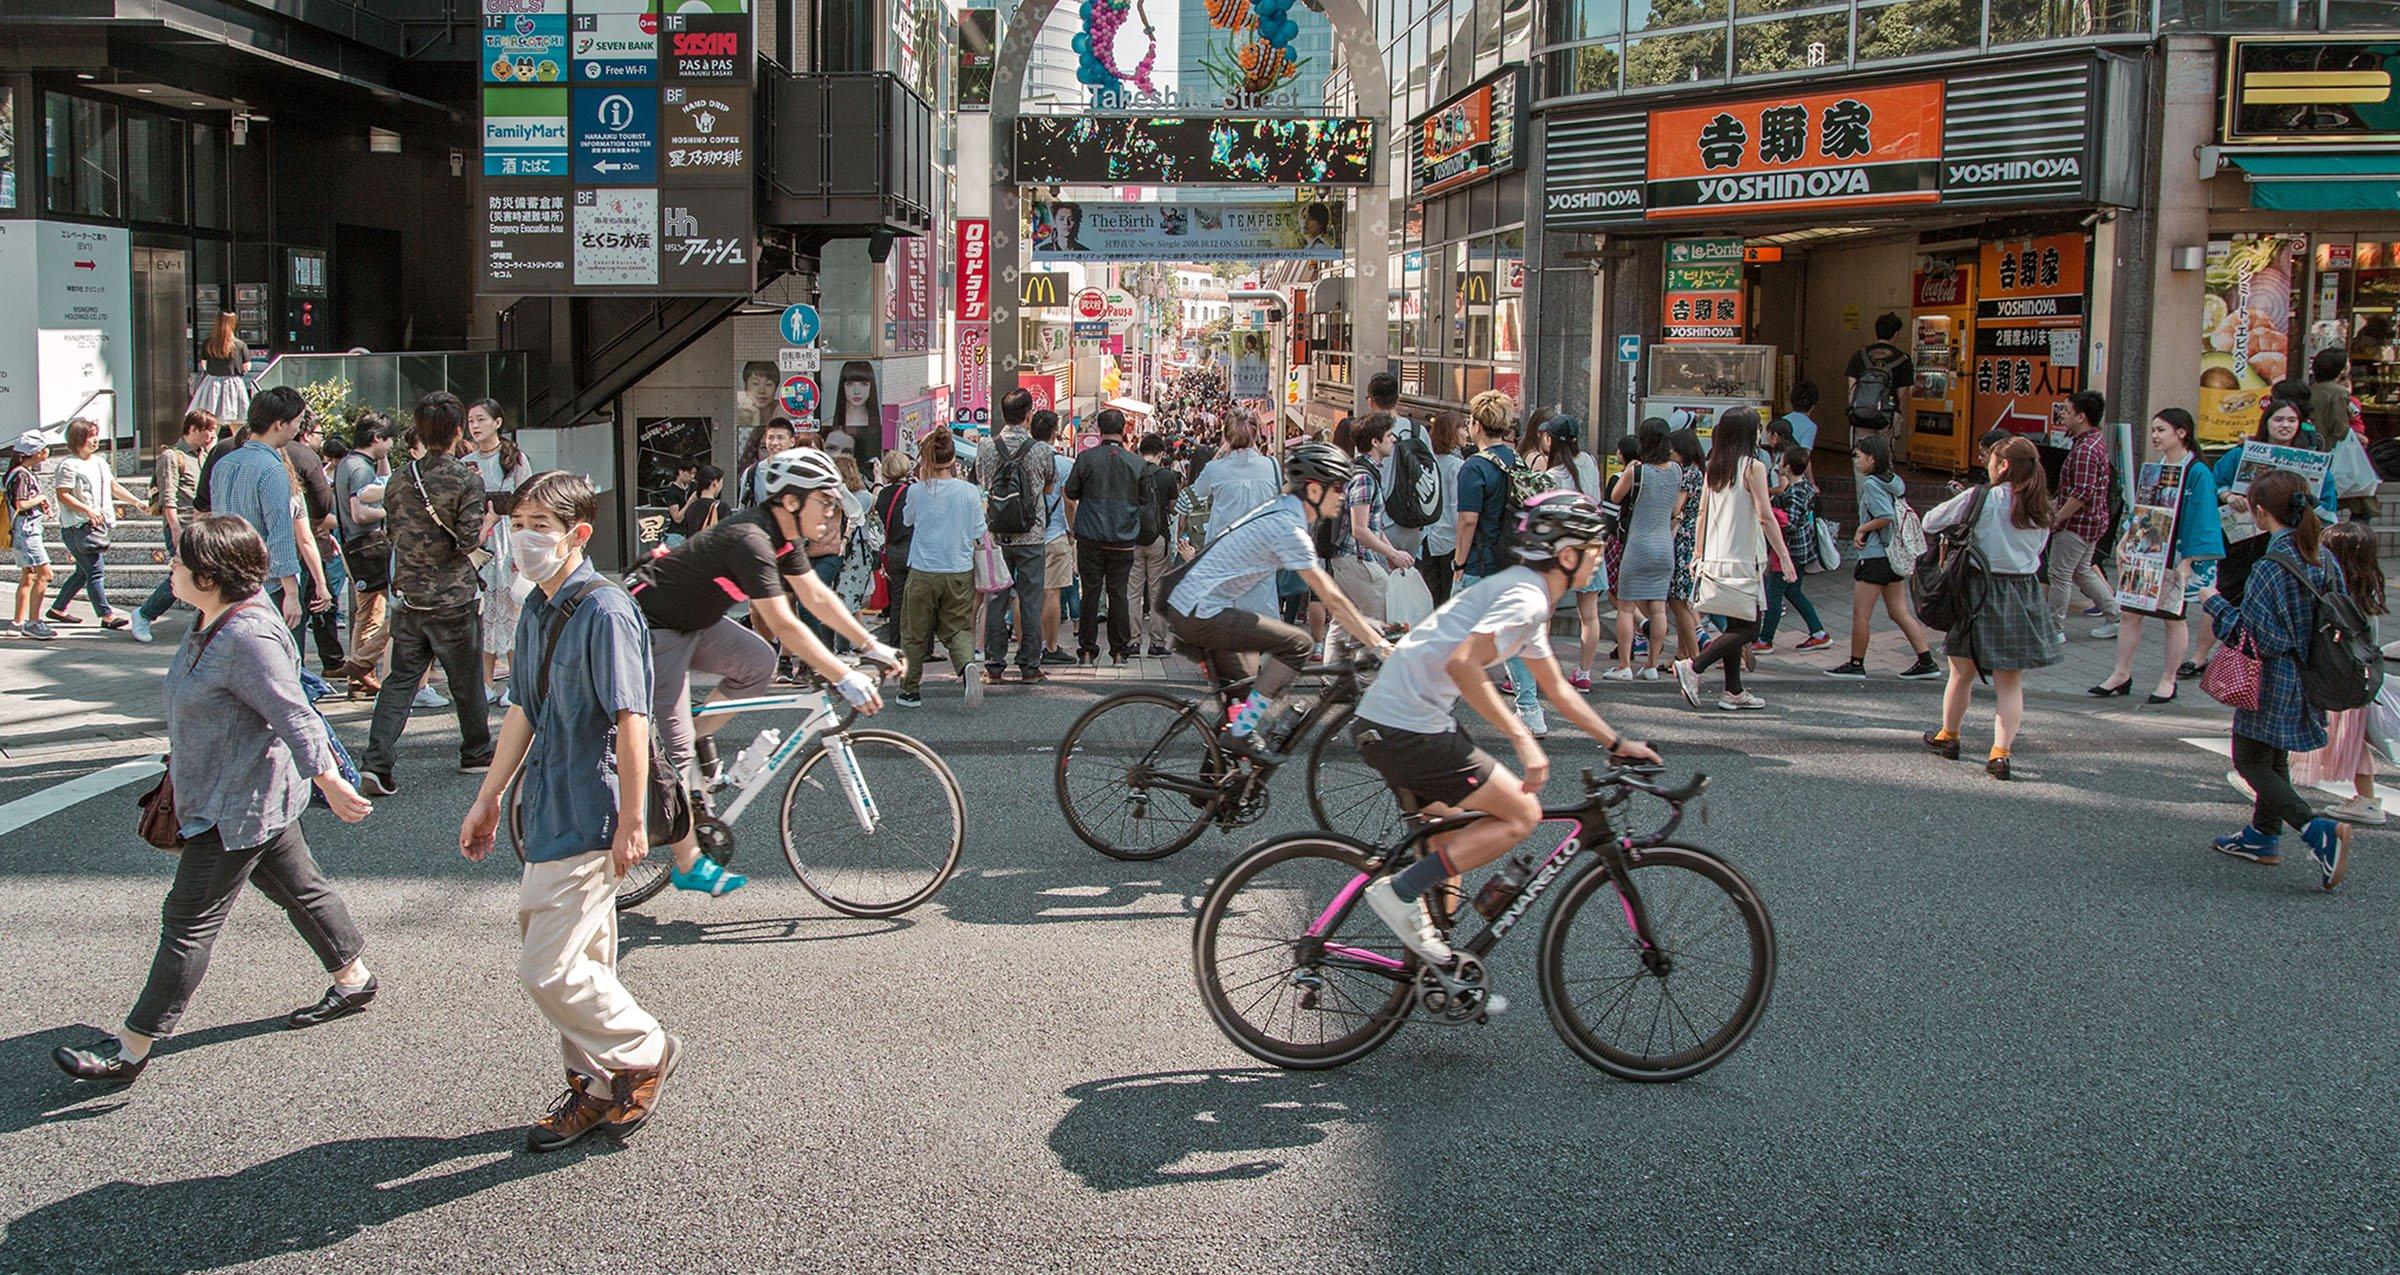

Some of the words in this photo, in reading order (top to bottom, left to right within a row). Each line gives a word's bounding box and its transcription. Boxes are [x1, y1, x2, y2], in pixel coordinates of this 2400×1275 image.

[486, 15, 502, 28] 1F
[577, 17, 592, 30] 1F
[667, 16, 682, 30] 1F
[597, 41, 626, 50] SEVEN
[628, 41, 654, 50] BANK
[673, 32, 737, 56] SASAKI
[605, 65, 624, 75] Free
[625, 65, 647, 75] Wi-Fi
[680, 59, 700, 70] PAS
[712, 59, 733, 70] PAS
[667, 89, 682, 102] BF
[1224, 86, 1300, 110] Street
[682, 100, 707, 114] HAND
[709, 100, 730, 112] DRIP
[487, 124, 566, 141] FamilyMart
[671, 136, 707, 144] HOSHINO
[709, 136, 739, 144] COFFEE
[1698, 98, 1872, 171] 吉野家
[668, 148, 743, 168] 星乃珈琲
[502, 158, 516, 174] 酒
[521, 159, 550, 173] たばこ
[1949, 157, 2080, 184] YOSHINOYA
[1697, 168, 1870, 203] YOSHINOYA
[578, 191, 592, 204] BF
[1548, 189, 1640, 210] YOSHINOYA
[1089, 213, 1117, 227] The
[1119, 213, 1154, 227] Birth
[1228, 213, 1291, 228] TEMPEST
[582, 232, 652, 248] さくら水産
[1156, 240, 1181, 249] Single
[1220, 240, 1231, 248] ON
[1233, 240, 1254, 248] SALE
[679, 238, 746, 265] アッシュ
[157, 260, 181, 270] EV-1
[965, 223, 985, 318] OSドラッグ
[2000, 246, 2060, 291] 吉野家
[1107, 304, 1133, 318] Pausa
[1672, 298, 1737, 322] 吉野家
[1997, 299, 2057, 316] YOSHINOYA
[1670, 327, 1734, 337] YOSHINOYA
[784, 361, 792, 369] 11
[807, 361, 816, 369] 18
[1491, 838, 1580, 938] PINARELLO
